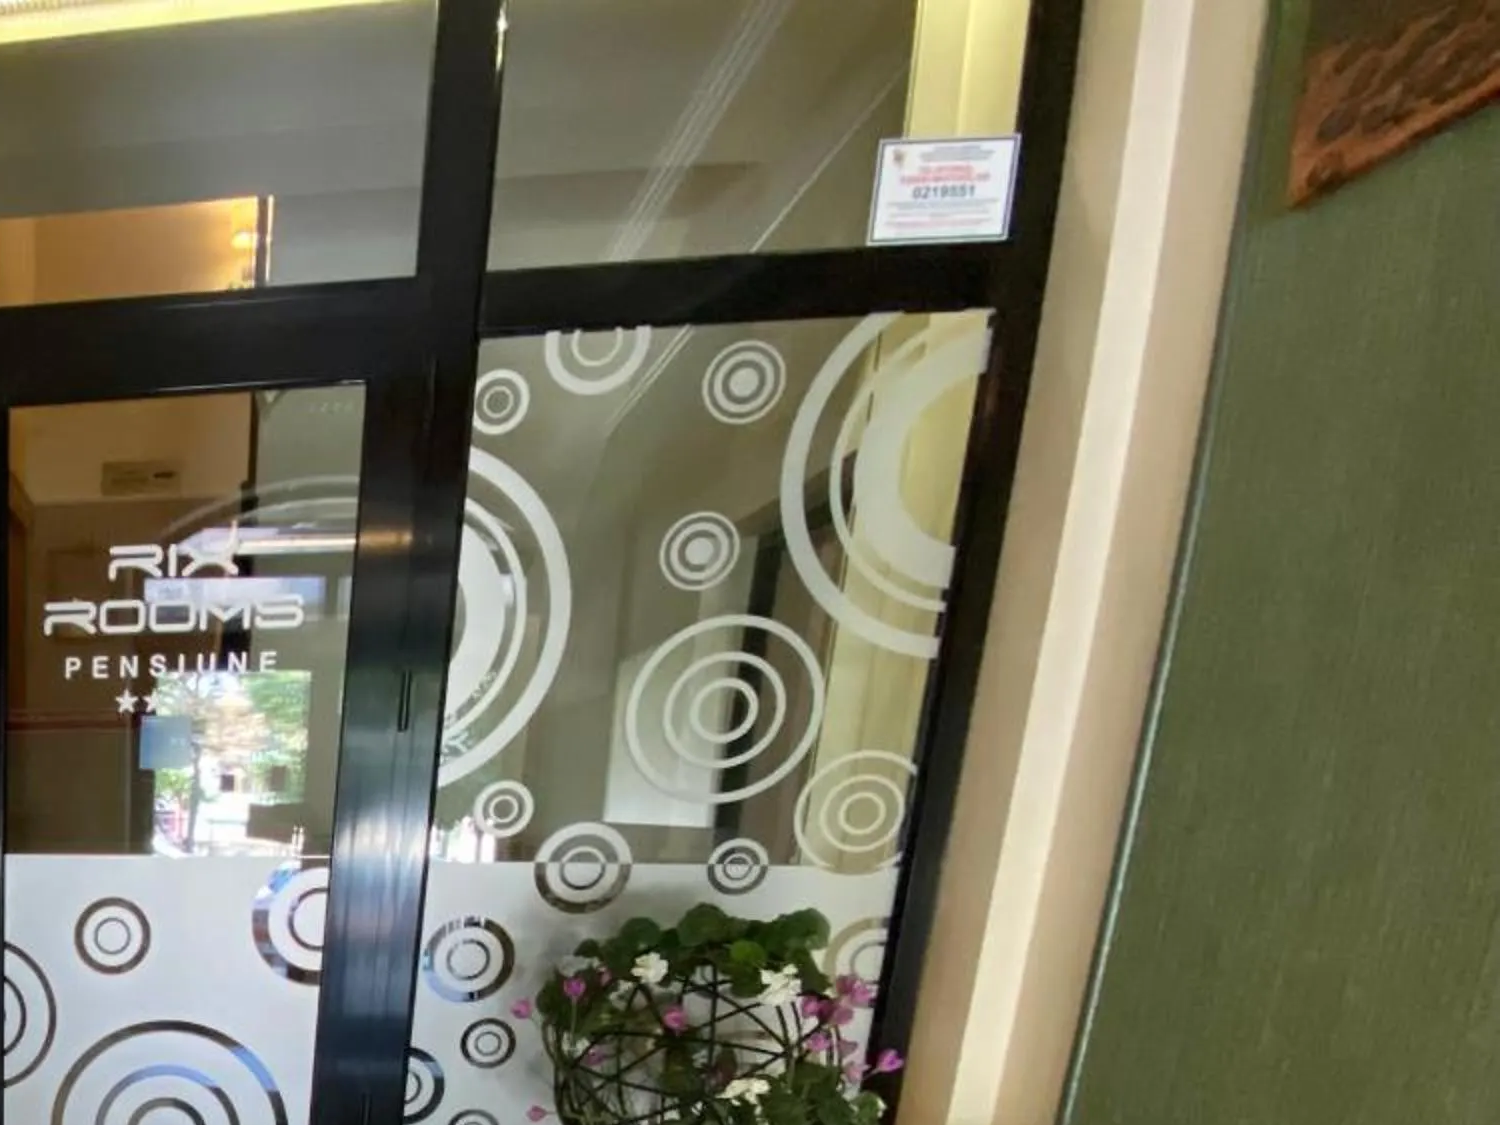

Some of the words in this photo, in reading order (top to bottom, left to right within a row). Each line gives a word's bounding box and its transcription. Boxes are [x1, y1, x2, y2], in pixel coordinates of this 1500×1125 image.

[108, 528, 240, 582] RIX
[43, 594, 305, 636] ROOMS
[64, 651, 278, 680] PENSIUNE
